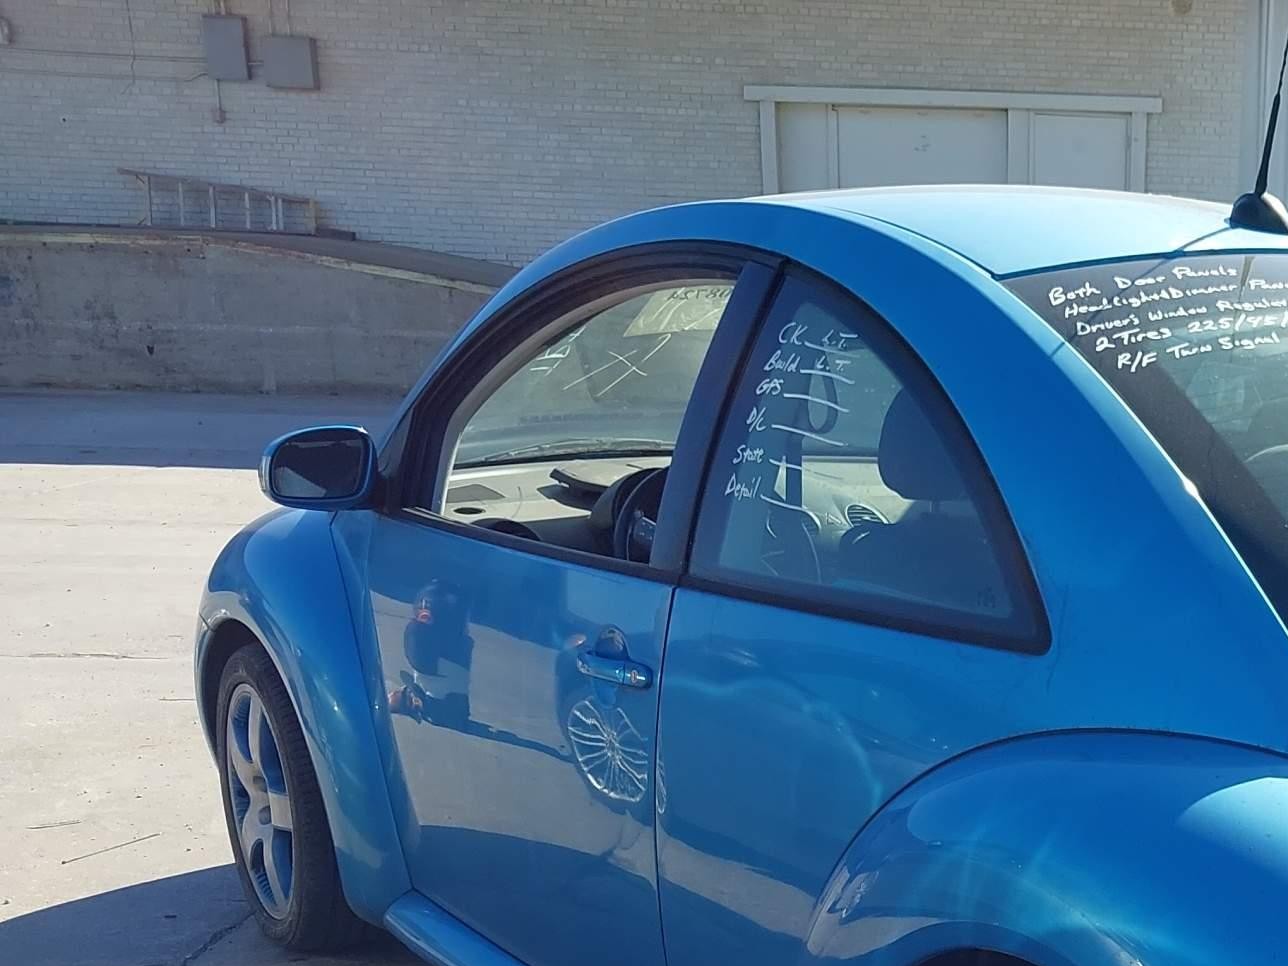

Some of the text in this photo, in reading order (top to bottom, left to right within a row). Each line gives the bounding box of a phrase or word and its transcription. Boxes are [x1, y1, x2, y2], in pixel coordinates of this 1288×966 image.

[1048, 265, 1238, 306] Both Door Panels
[1148, 306, 1207, 321] Window
[778, 321, 808, 345] CK
[1112, 328, 1173, 345] Tires
[1117, 351, 1158, 373] R/F
[1218, 331, 1281, 350] Signal
